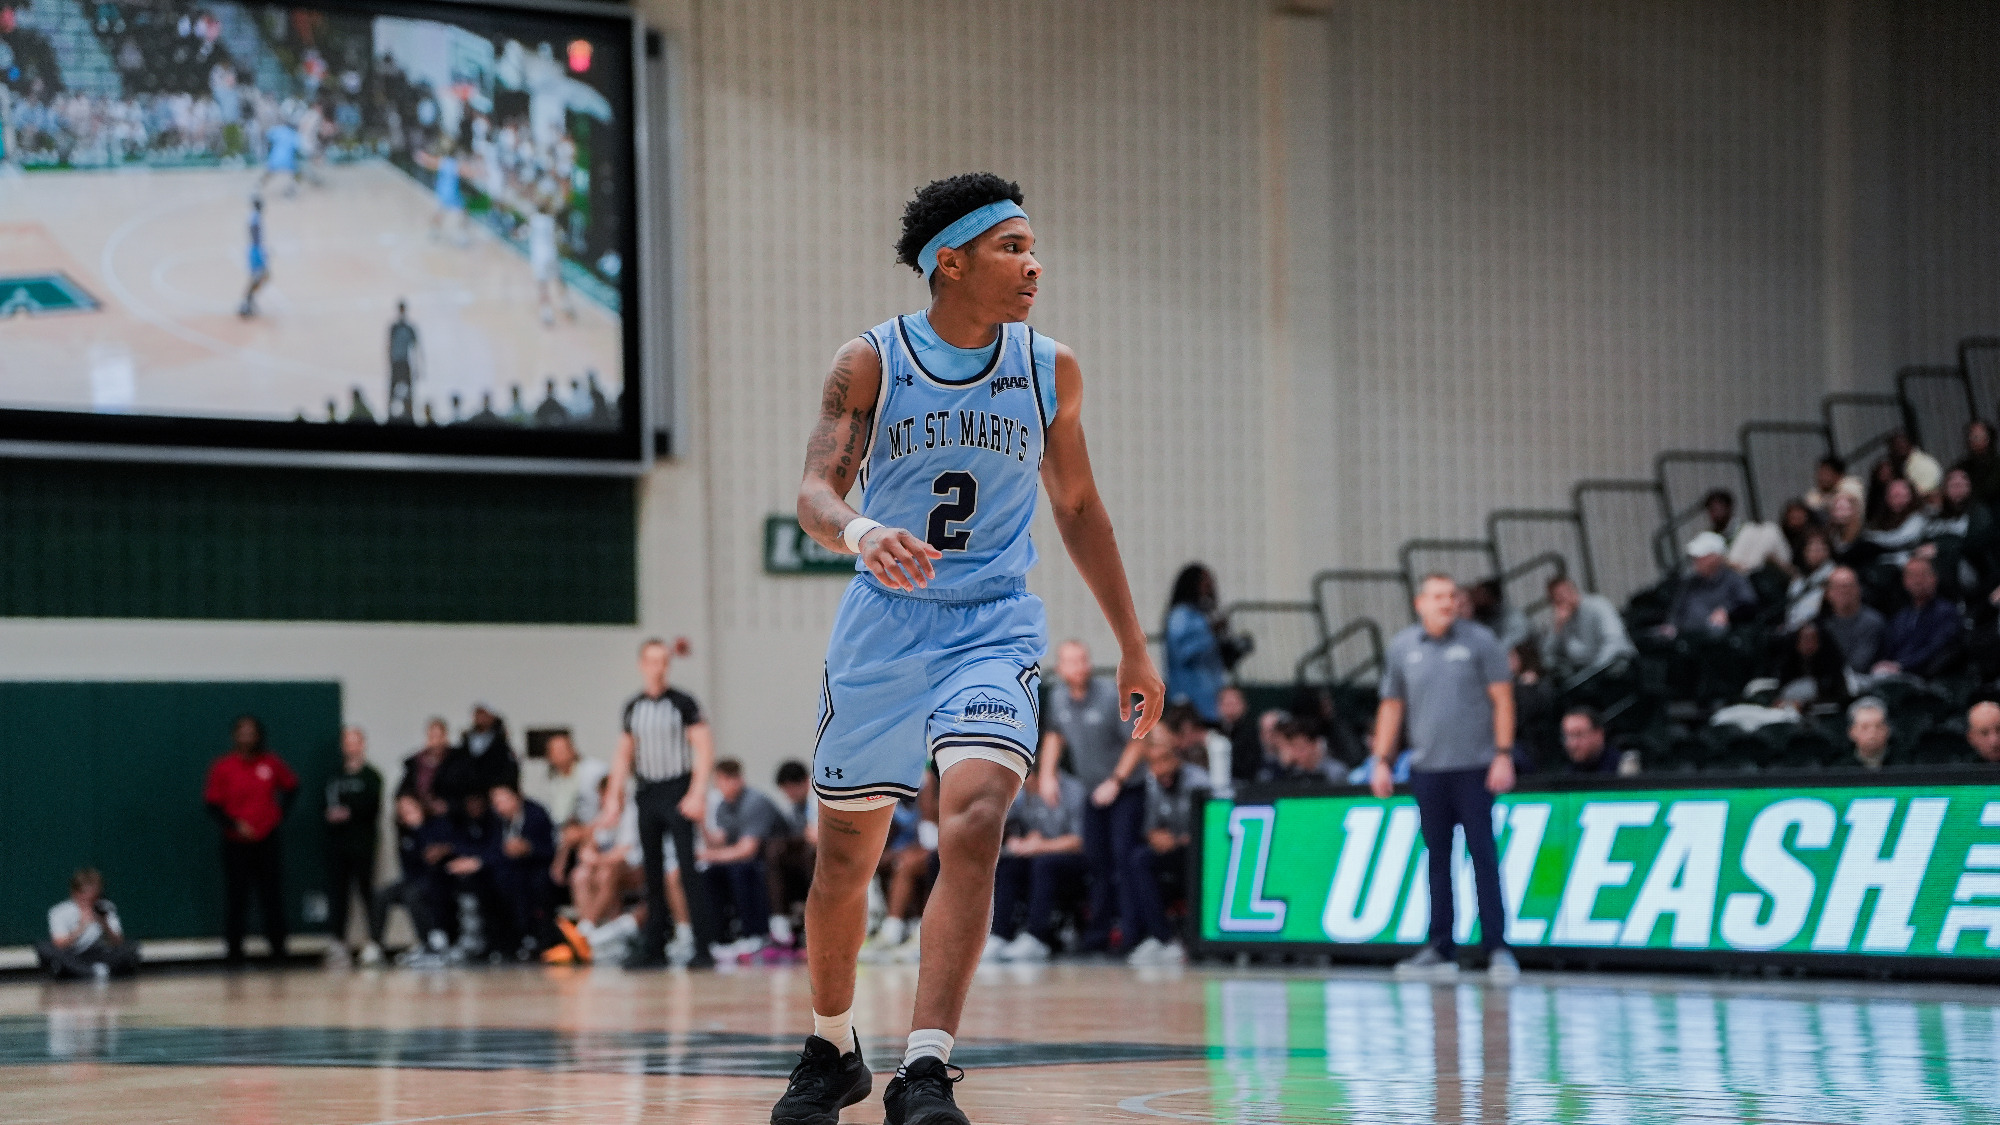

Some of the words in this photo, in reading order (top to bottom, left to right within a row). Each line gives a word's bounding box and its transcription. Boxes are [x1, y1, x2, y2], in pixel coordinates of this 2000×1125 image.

[990, 376, 1030, 399] MAAC
[888, 416, 918, 461] MT.
[925, 410, 953, 449] ST.
[959, 409, 1029, 462] MARY'S
[925, 470, 978, 552] 2
[964, 703, 1018, 721] MOUNT
